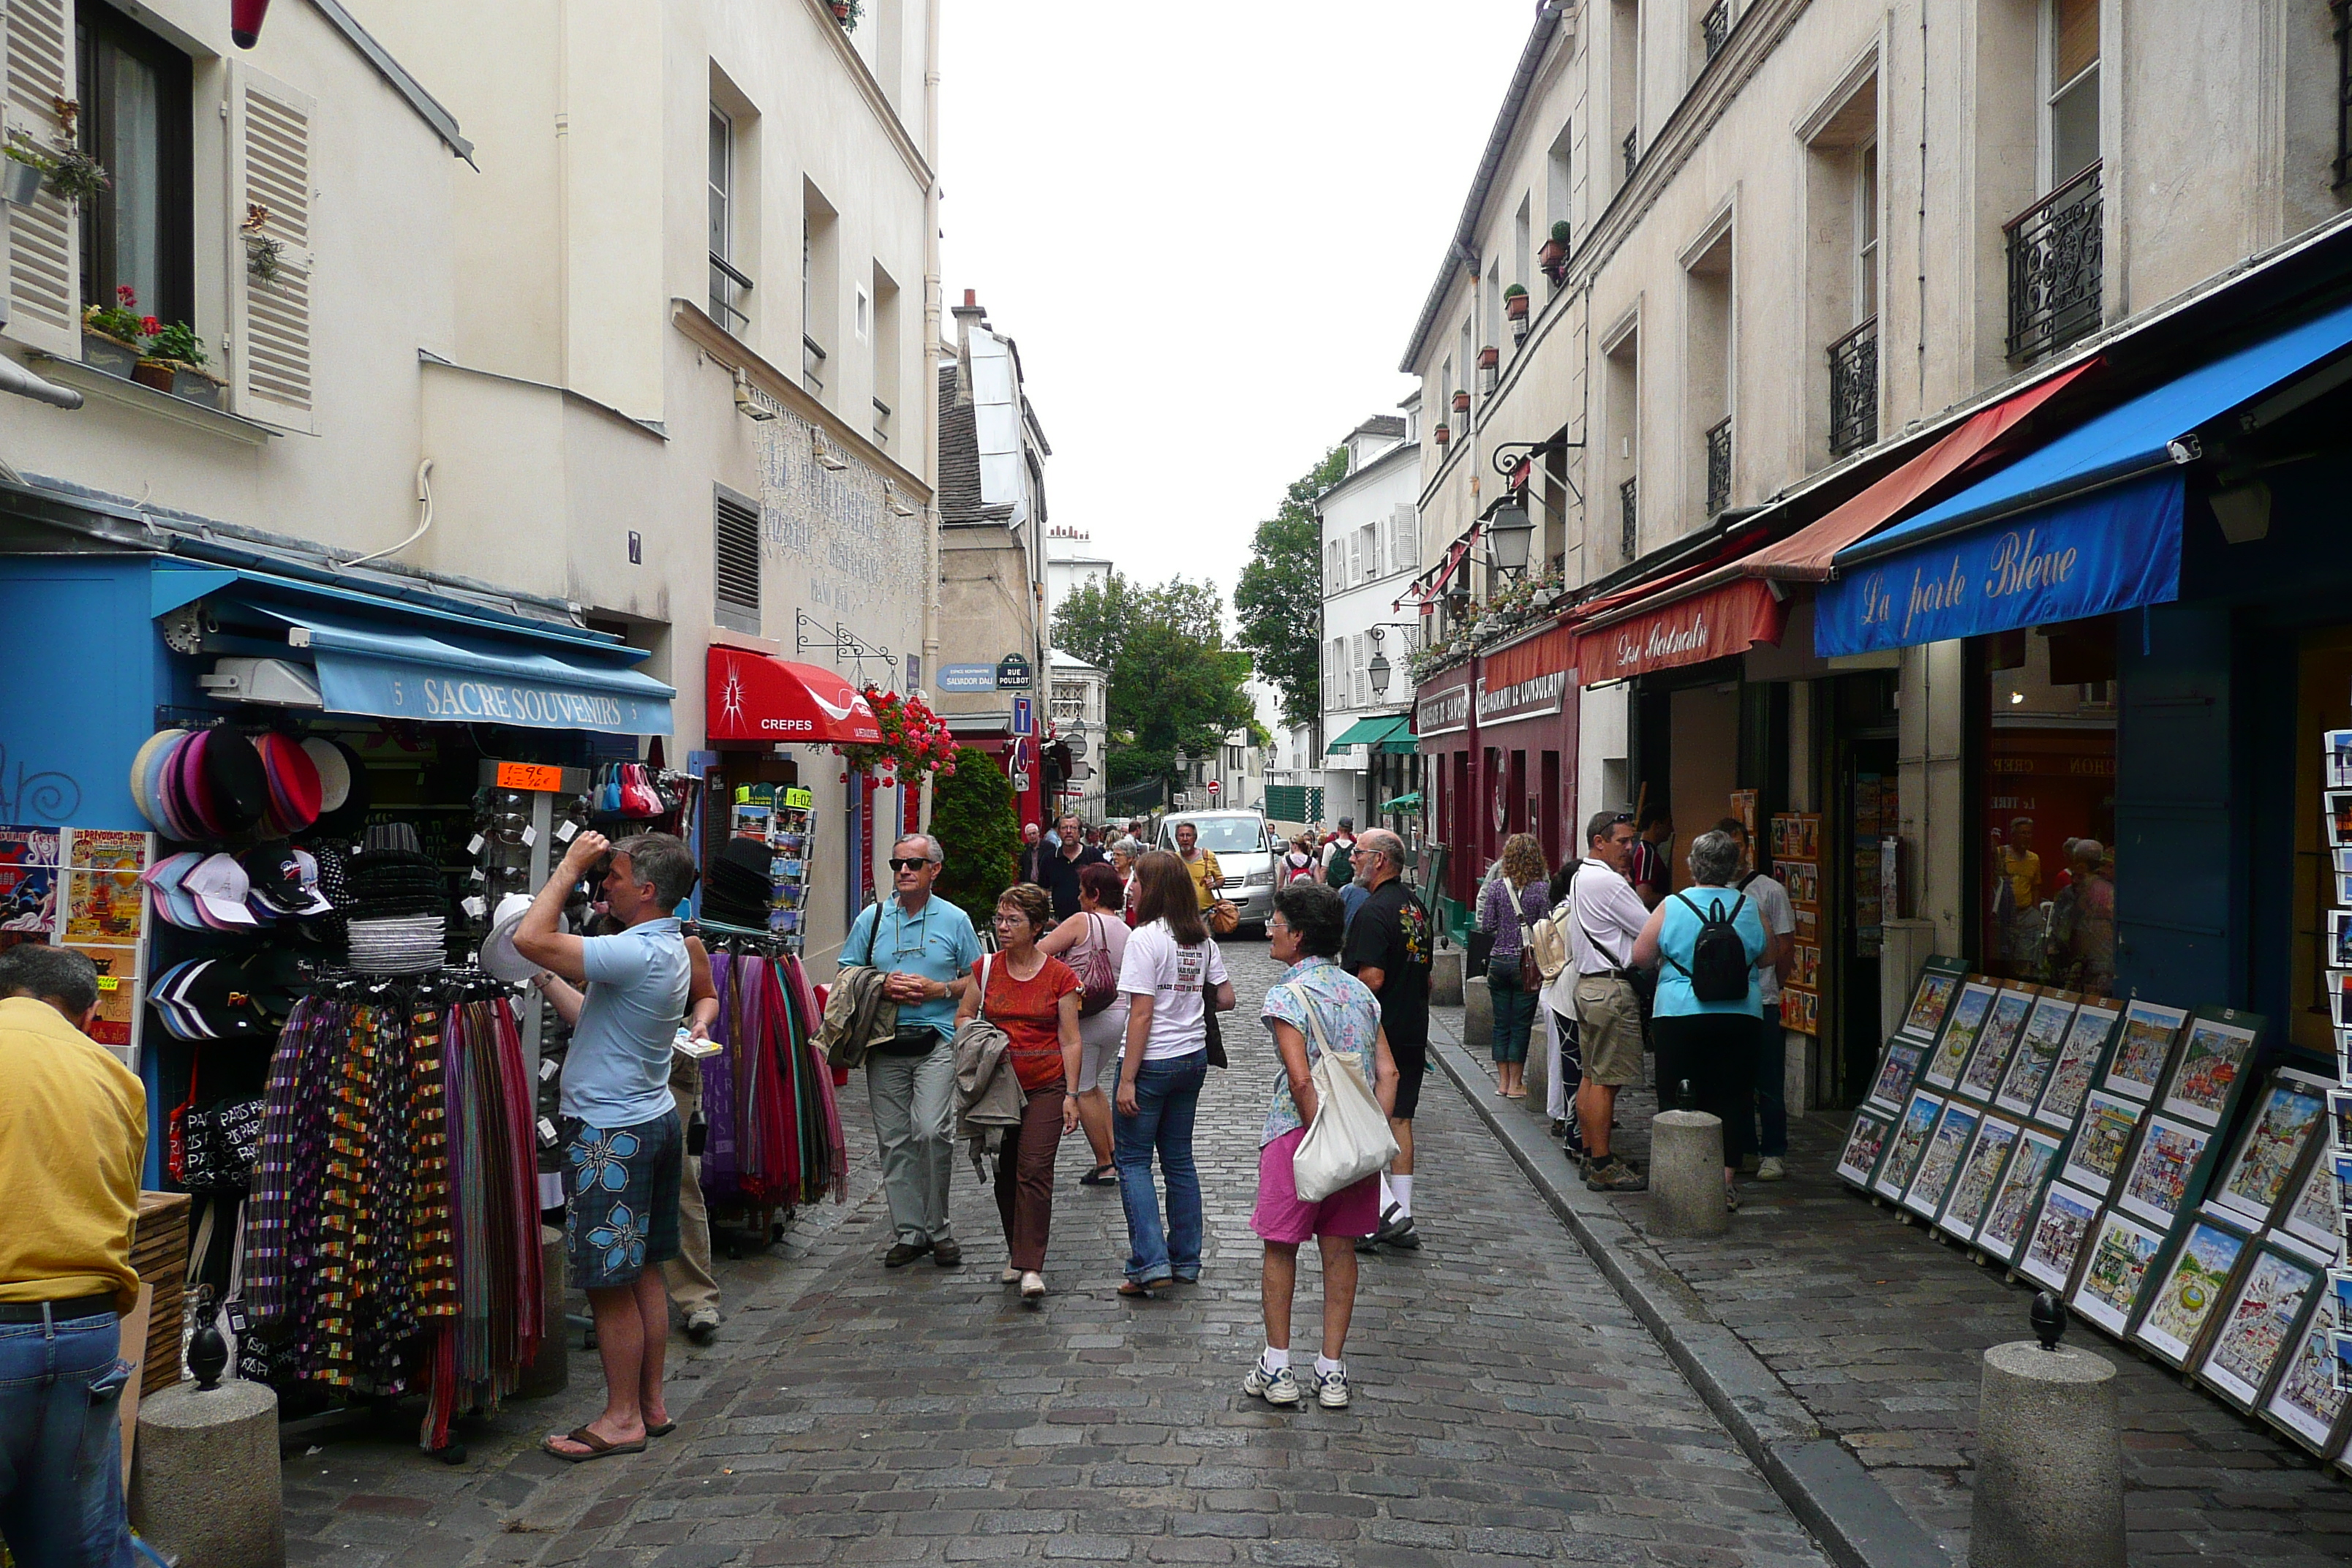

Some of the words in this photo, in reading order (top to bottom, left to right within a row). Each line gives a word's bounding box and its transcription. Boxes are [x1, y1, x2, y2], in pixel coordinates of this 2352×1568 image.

[631, 532, 638, 562] 7
[1860, 570, 1891, 625] La
[1903, 554, 1965, 639] porte
[1986, 528, 2076, 598] Bleue
[946, 677, 978, 686] SALVADOR
[999, 676, 1030, 685] POULBOT
[1512, 684, 1519, 706] LE
[1521, 672, 1558, 704] CONSULAT
[394, 682, 403, 706] 5
[424, 678, 512, 719] SACRE
[512, 690, 621, 725] SOUVENIRS
[1447, 696, 1468, 721] SAVOIE
[761, 718, 813, 731] CREPES
[106, 1006, 132, 1019] NOIR
